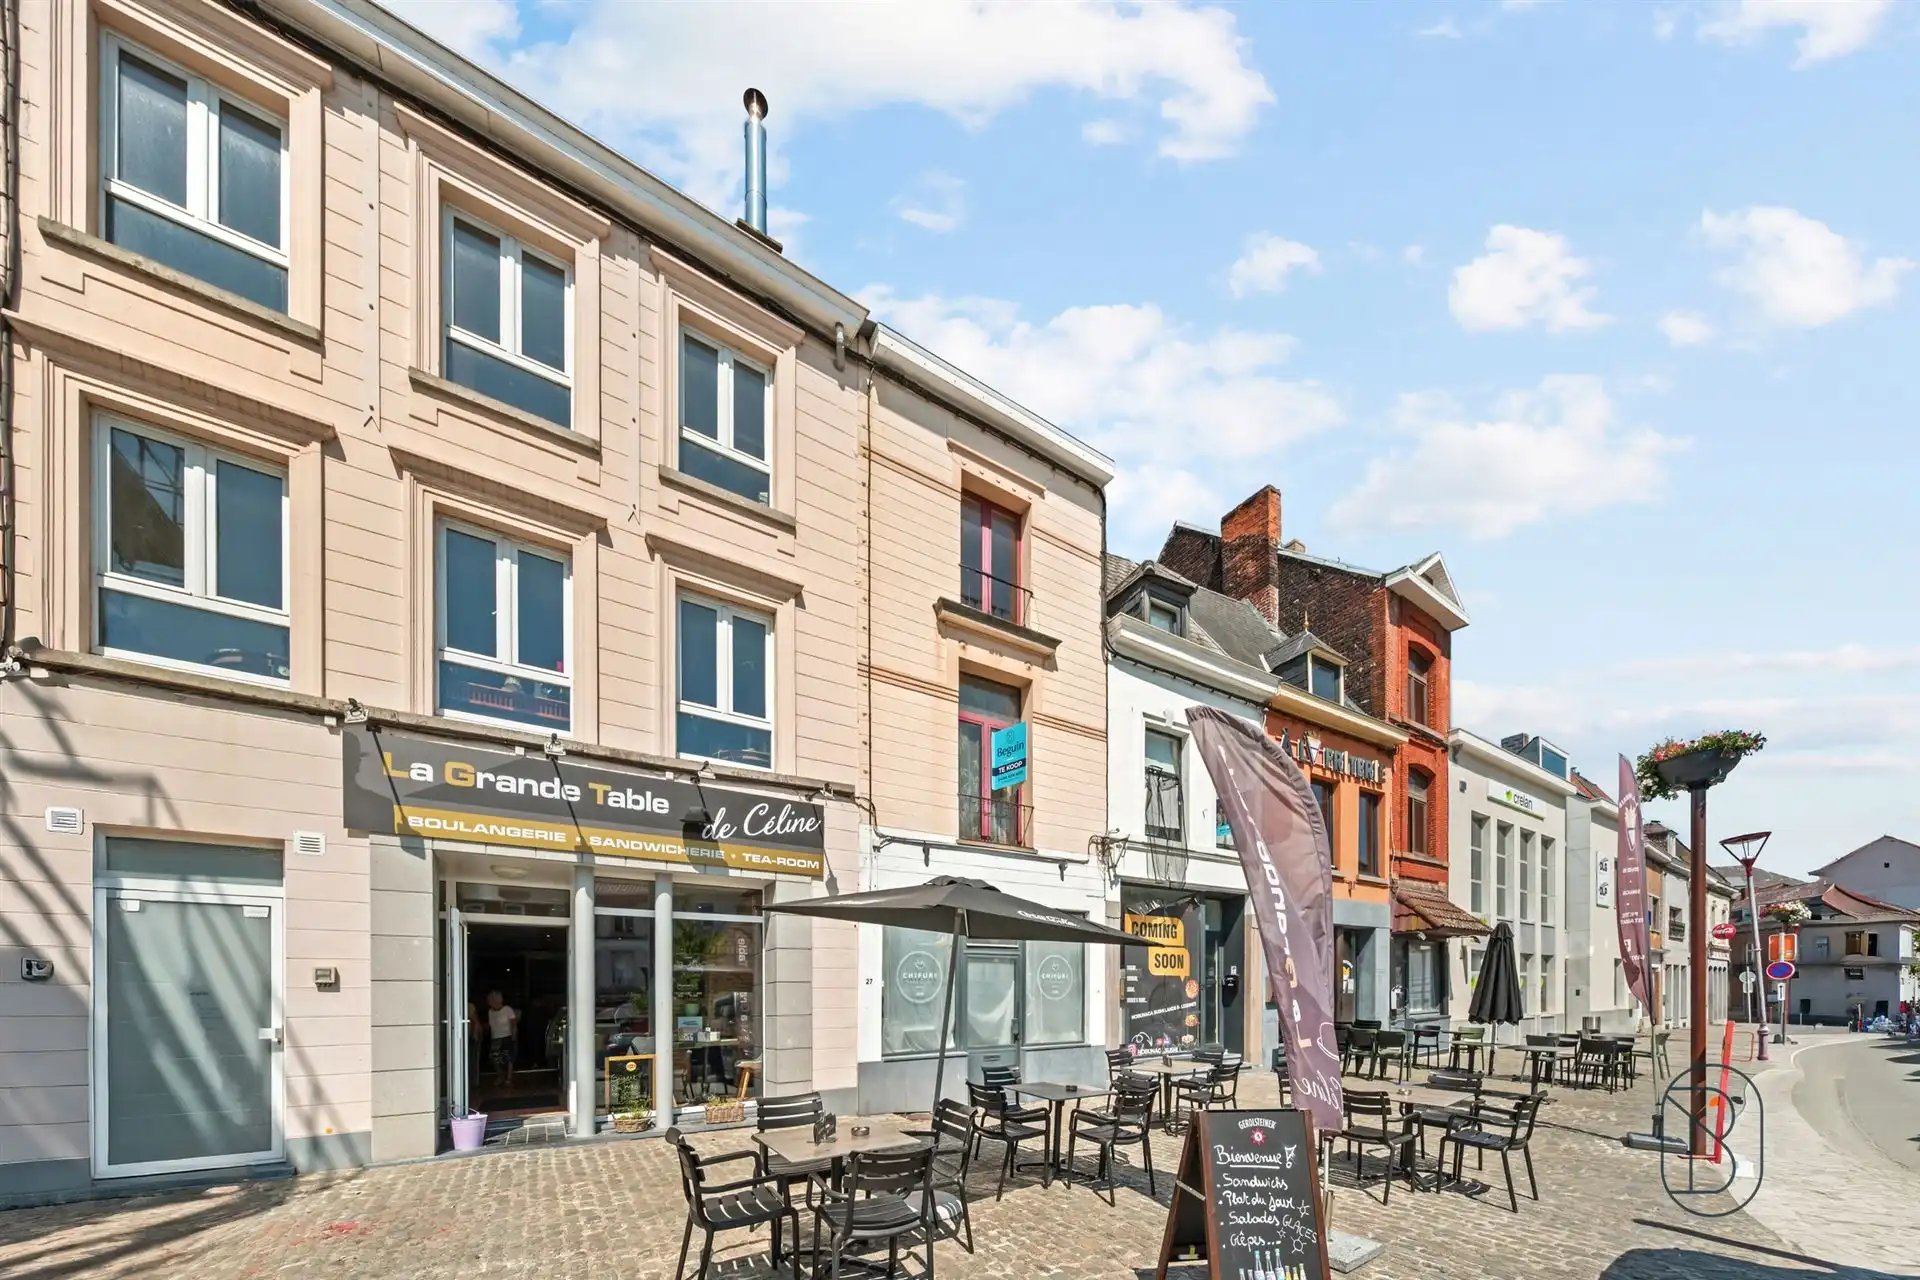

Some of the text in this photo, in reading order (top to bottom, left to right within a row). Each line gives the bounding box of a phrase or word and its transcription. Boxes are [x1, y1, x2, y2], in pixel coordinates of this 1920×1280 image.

[997, 741, 1024, 757] Beguin
[998, 760, 1023, 774] TE KOOP
[383, 751, 822, 840] La Grande Table de Céline
[1513, 793, 1533, 811] crelan
[408, 815, 820, 869] BOULANGERIE SANDWICHERIE TEA-ROOM
[1132, 921, 1178, 939] COMING
[1154, 953, 1185, 969] SOON
[1237, 1118, 1277, 1130] GEROLSTEINER
[1222, 1190, 1296, 1212] Plat du jour
[1229, 1210, 1280, 1226] Salades
[1282, 1214, 1318, 1244] GLACES
